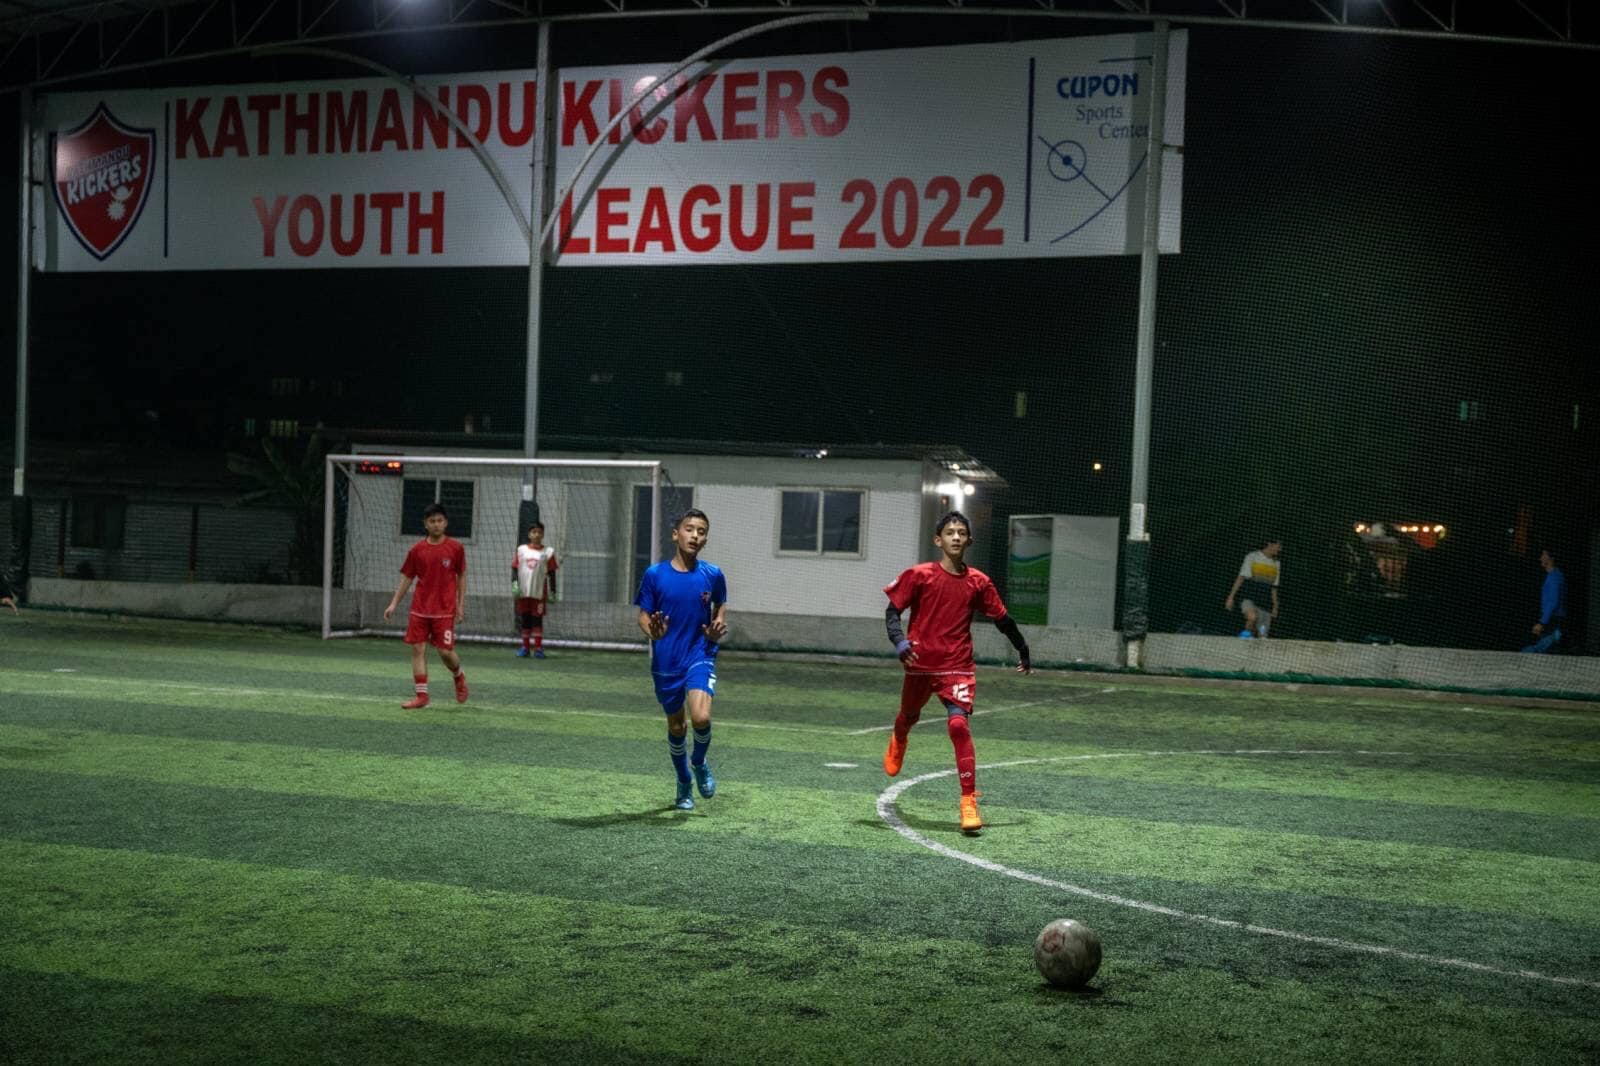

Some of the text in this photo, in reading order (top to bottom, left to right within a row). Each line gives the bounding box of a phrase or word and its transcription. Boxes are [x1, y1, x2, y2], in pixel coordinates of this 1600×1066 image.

[1057, 74, 1138, 98] CUPON
[176, 67, 849, 159] KATHMANDU KICKERS
[1077, 104, 1123, 124] Sports
[1099, 123, 1149, 140] Center
[67, 155, 141, 205] KICKERS
[255, 174, 1005, 257] YOUTH LEAGUE 2022
[444, 630, 452, 645] 9
[952, 683, 969, 703] 12
